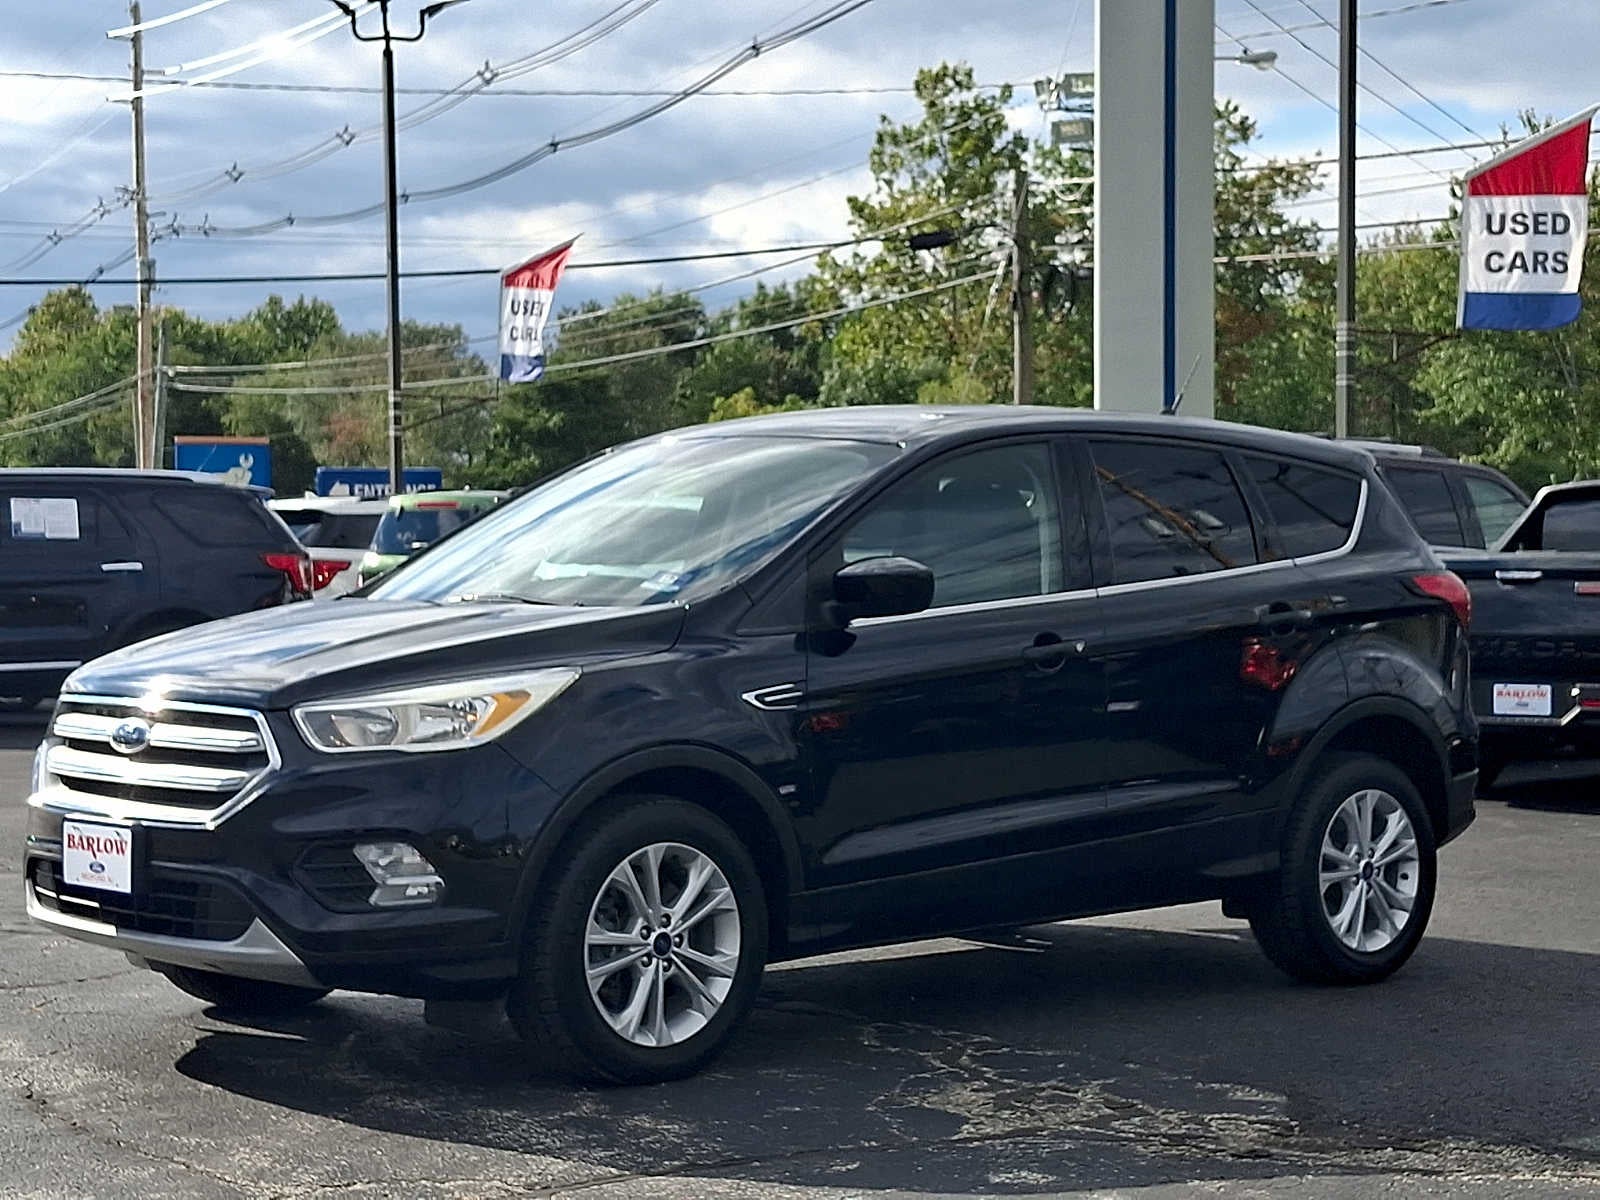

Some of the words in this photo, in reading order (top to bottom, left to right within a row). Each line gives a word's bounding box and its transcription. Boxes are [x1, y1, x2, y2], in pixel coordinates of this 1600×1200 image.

[1486, 212, 1571, 236] USED
[1484, 251, 1569, 274] CARS
[354, 483, 437, 497] ENTNC
[67, 832, 128, 860] BARLOW
